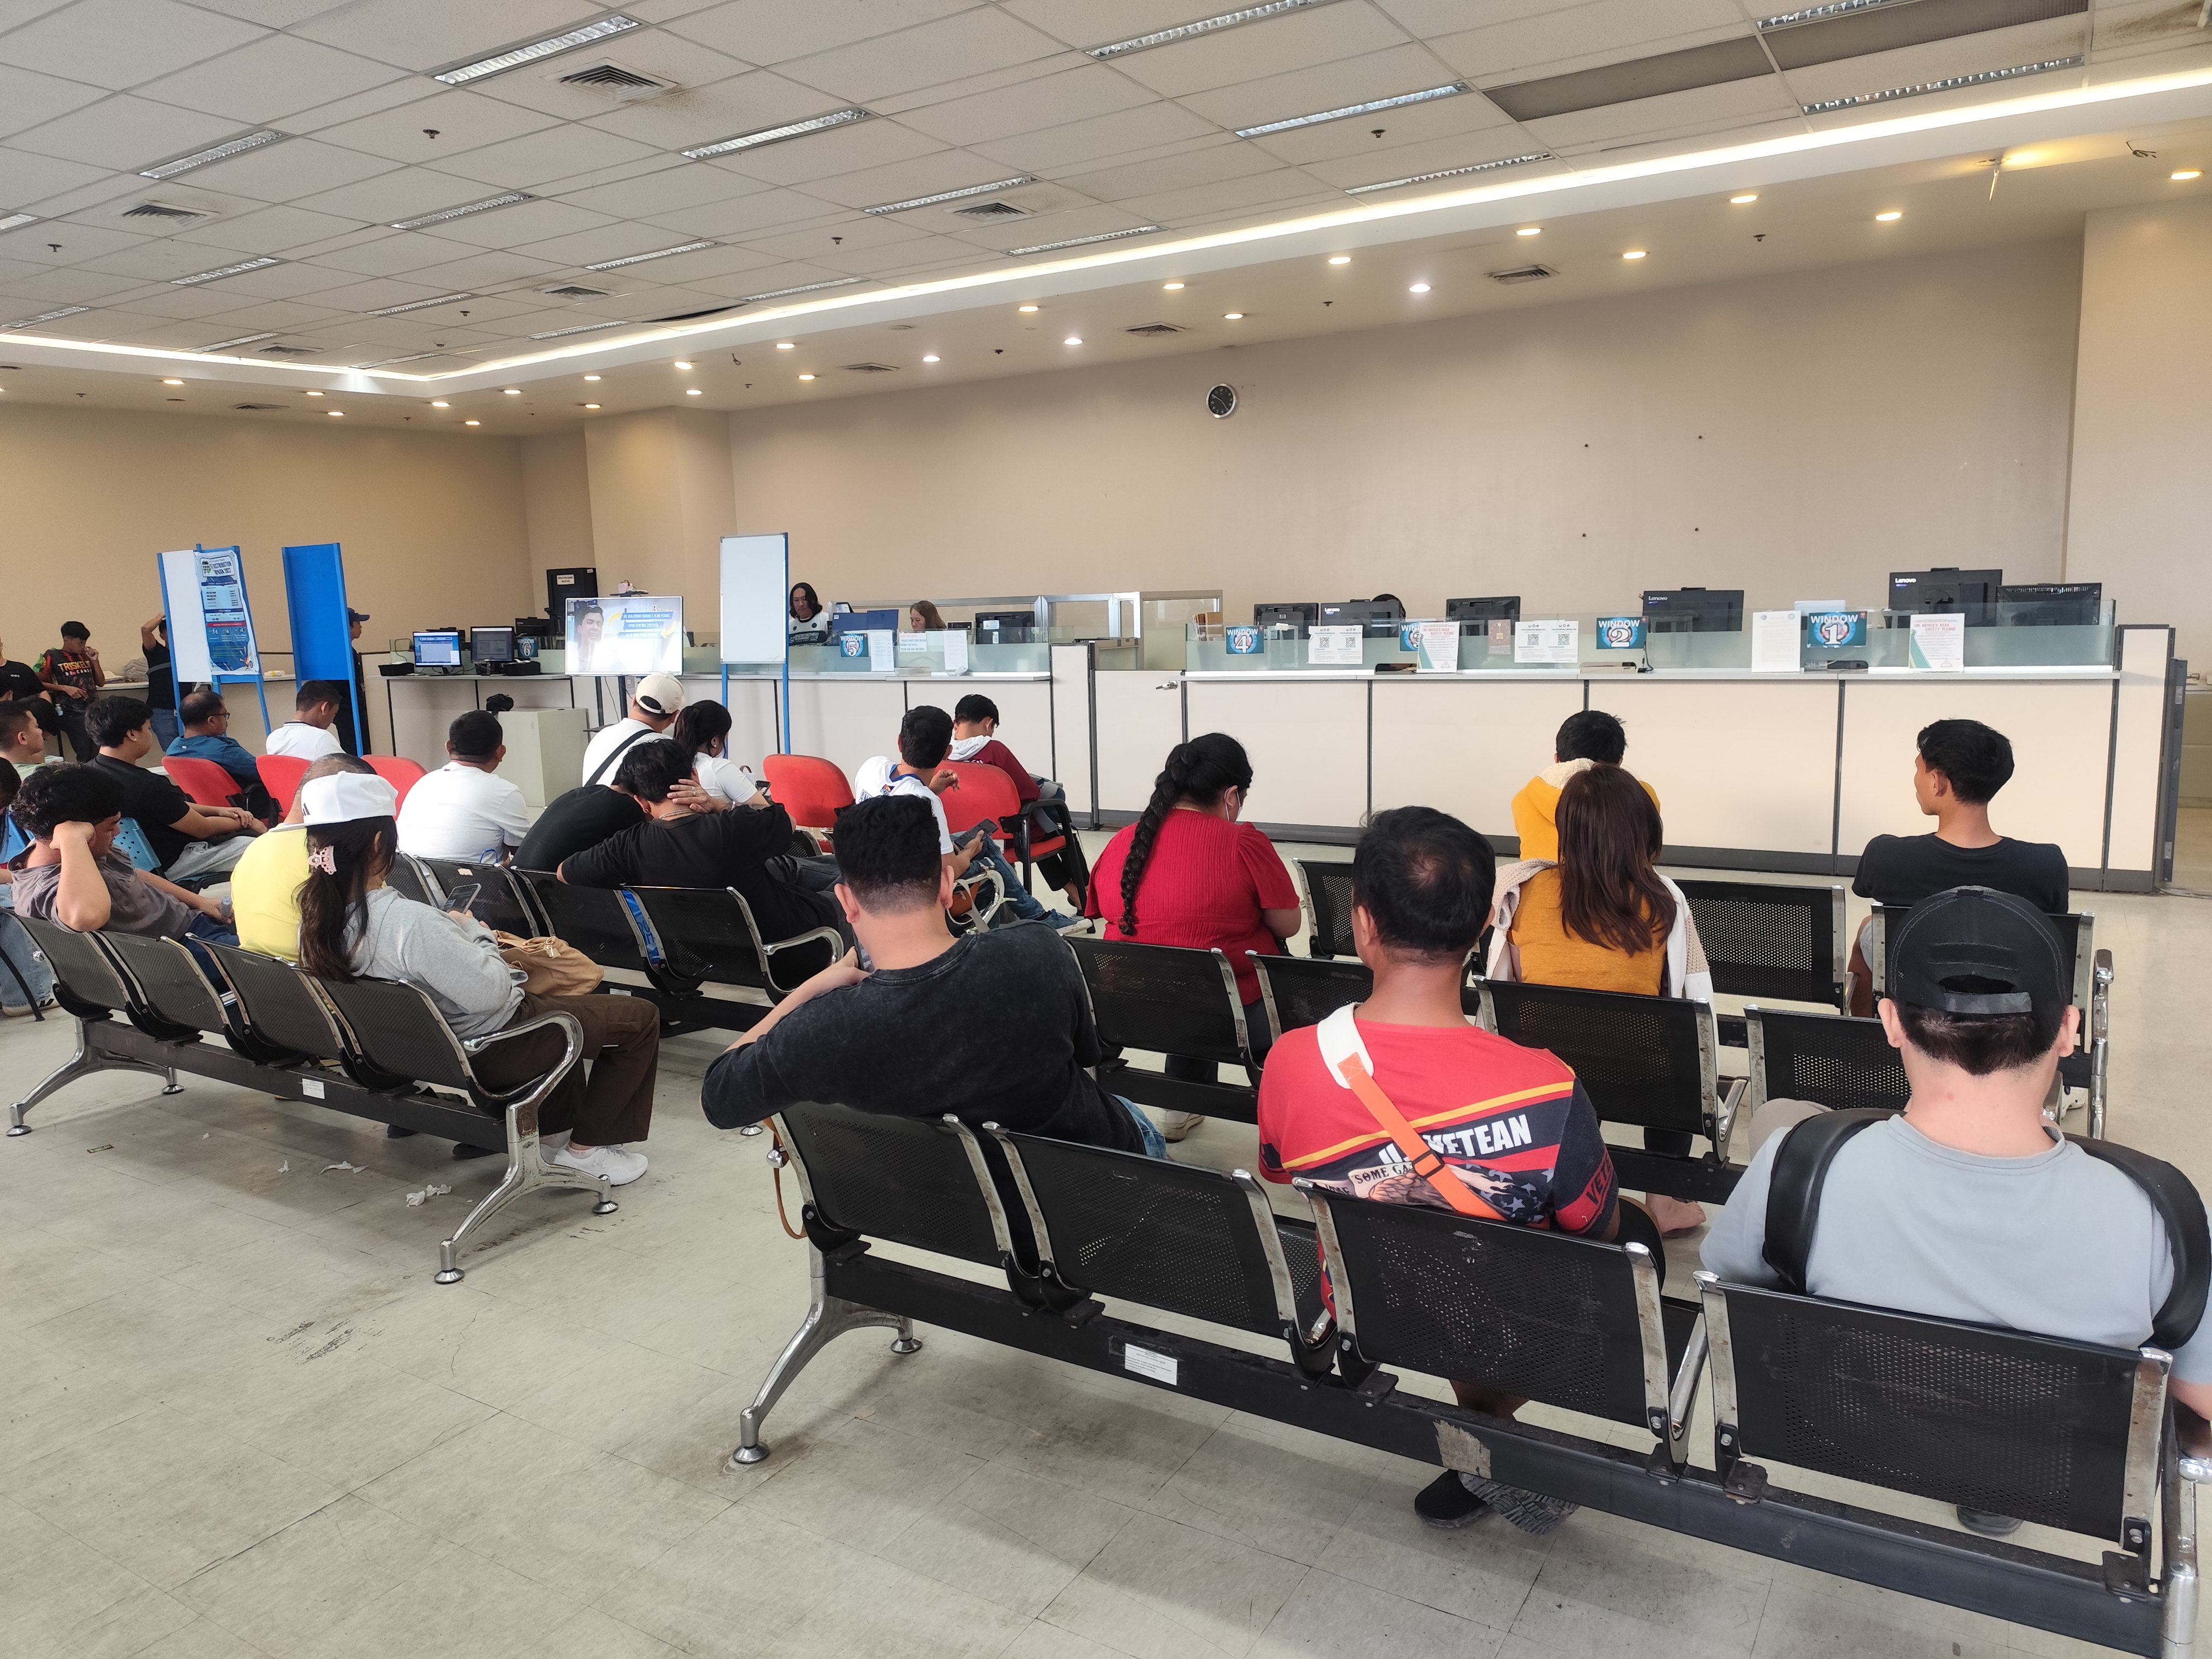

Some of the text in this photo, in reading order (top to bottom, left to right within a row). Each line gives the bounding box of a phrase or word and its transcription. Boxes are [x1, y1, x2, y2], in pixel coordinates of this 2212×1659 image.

[1598, 619, 1640, 628] WINDOW
[1811, 614, 1859, 624] WINDOW
[1610, 628, 1630, 647] 2
[1824, 623, 1842, 645] 1
[523, 644, 531, 657] 6
[847, 641, 858, 657] 5
[1235, 635, 1249, 653] 4
[1422, 1114, 1533, 1157] VETEAN
[1354, 1167, 1390, 1184] SOME
